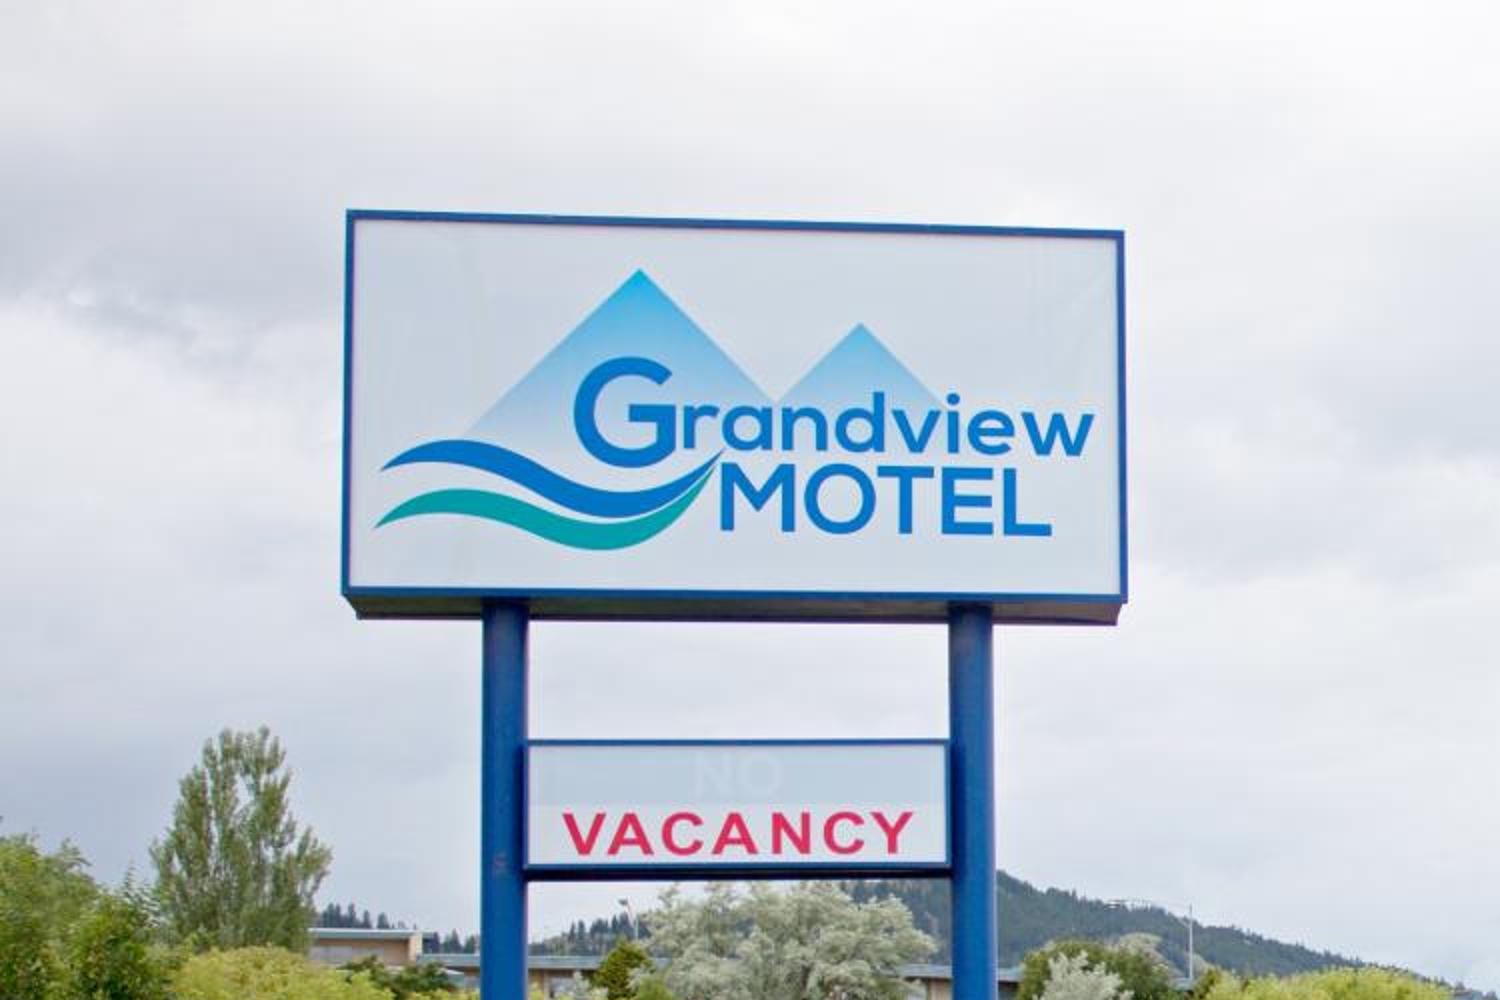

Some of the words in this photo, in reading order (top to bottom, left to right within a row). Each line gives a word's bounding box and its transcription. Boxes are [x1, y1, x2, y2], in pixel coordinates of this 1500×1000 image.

[573, 355, 1095, 469] Grandview
[719, 462, 1053, 538] MOTEL
[695, 750, 785, 798] NO
[562, 810, 914, 856] VACANCY
